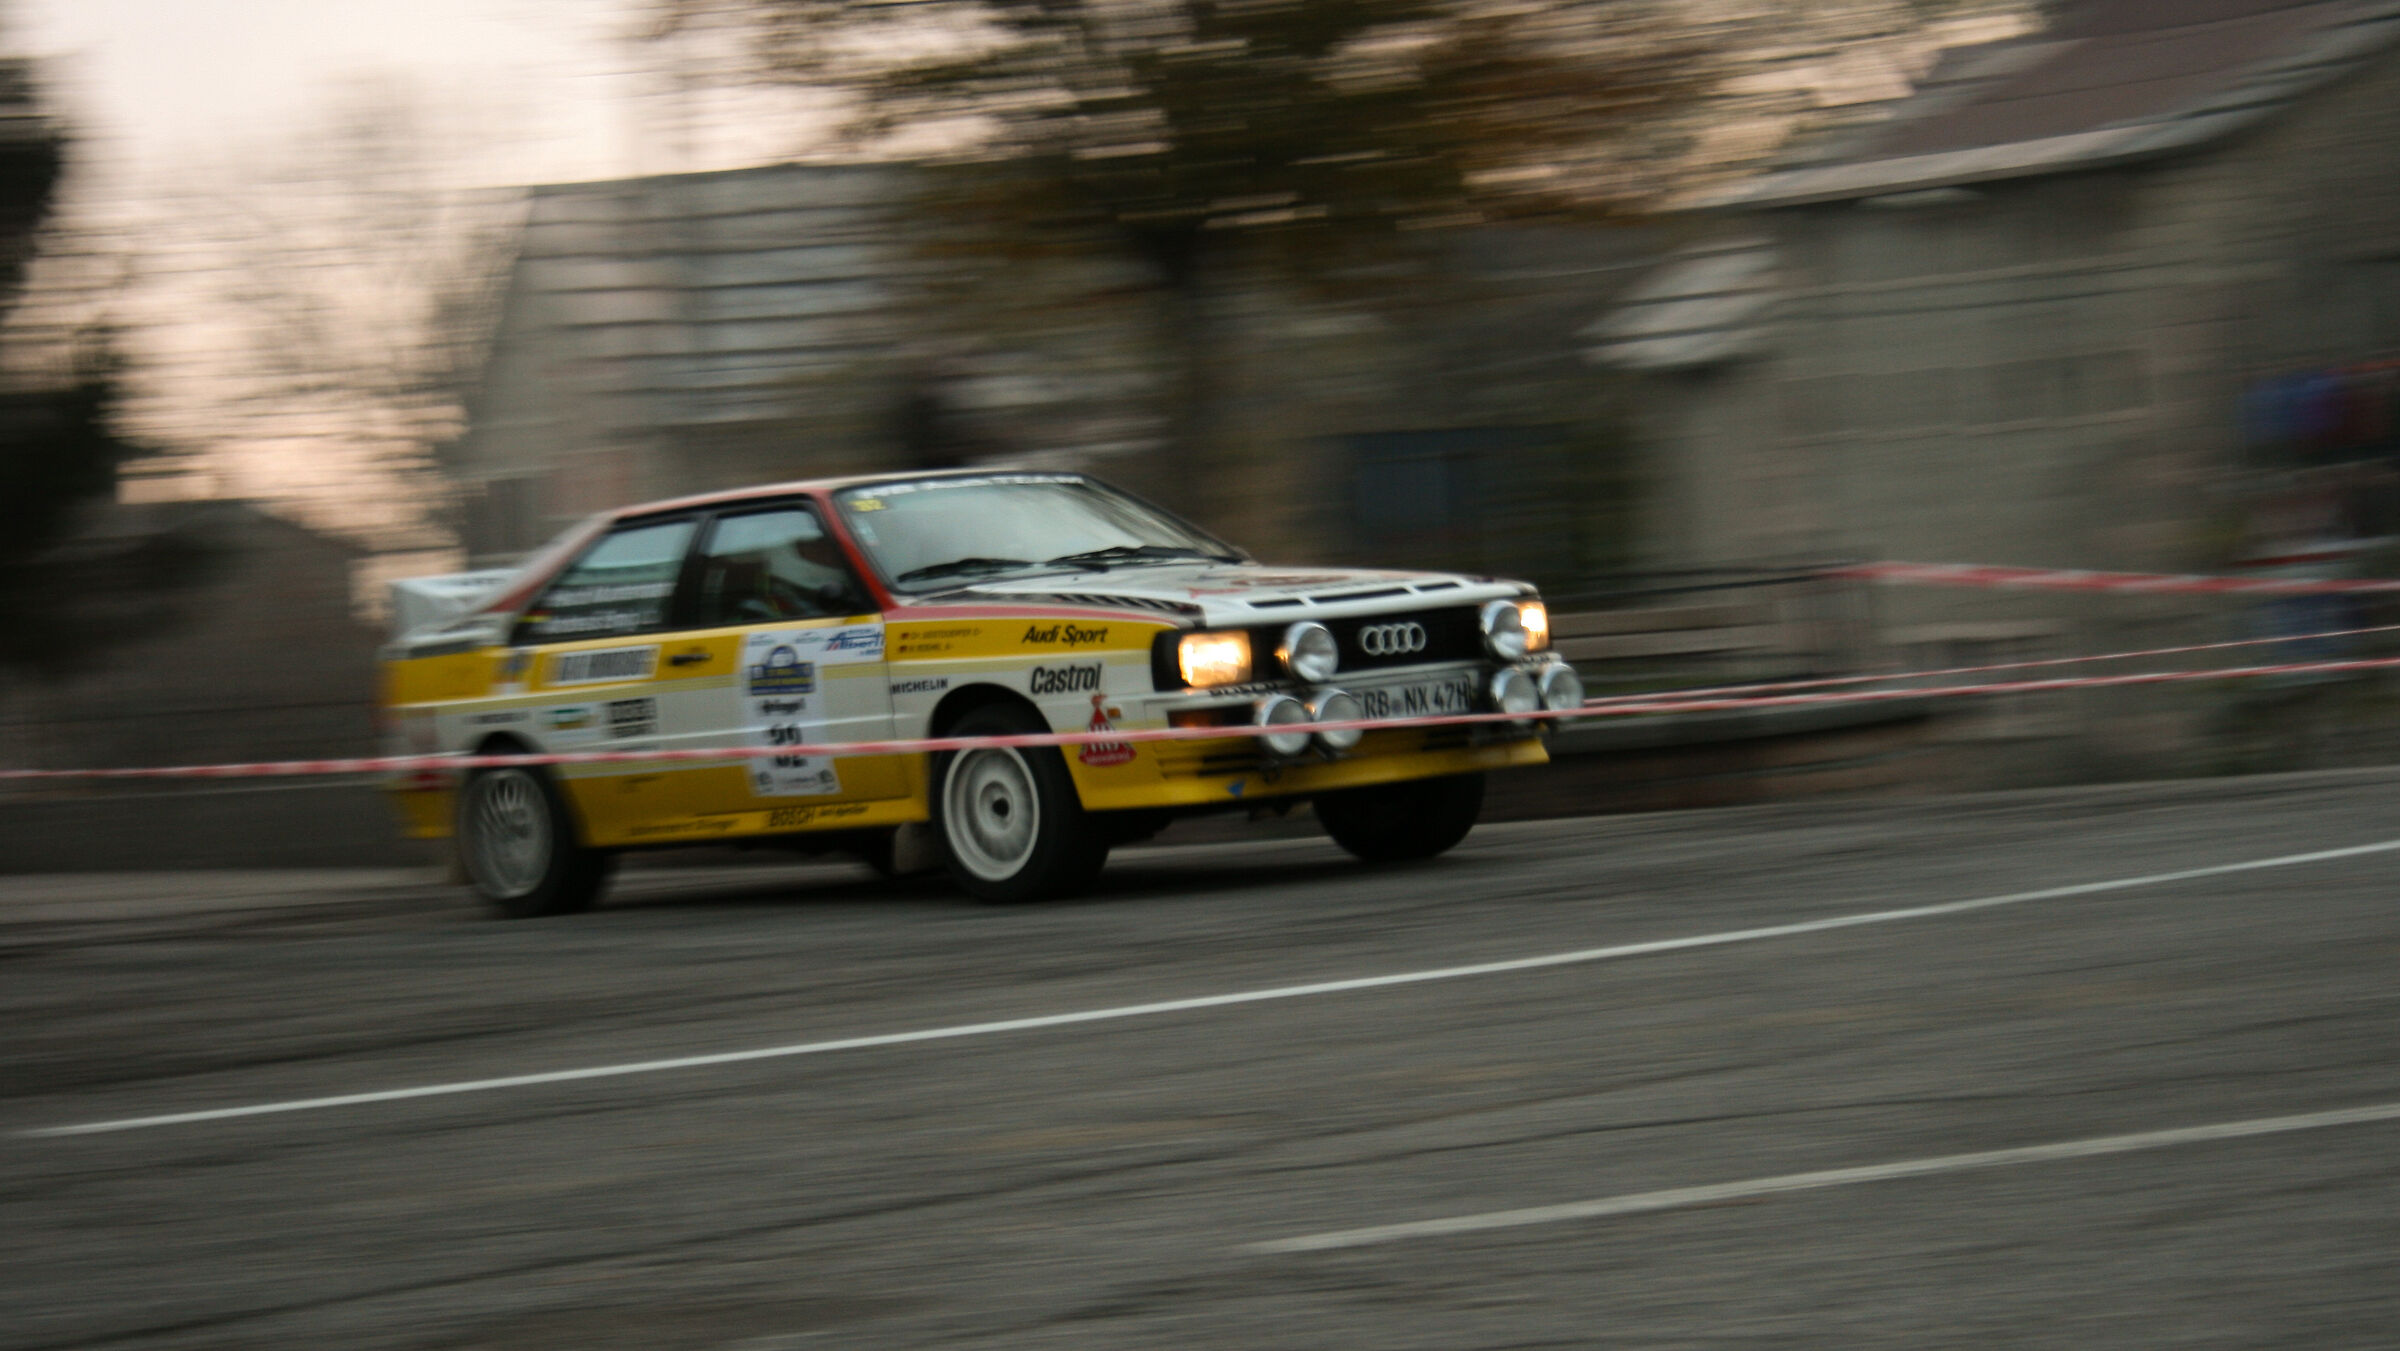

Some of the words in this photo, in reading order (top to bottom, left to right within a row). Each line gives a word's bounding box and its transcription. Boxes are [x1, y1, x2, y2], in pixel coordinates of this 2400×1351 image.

[1022, 625, 1061, 644] Audi
[1062, 624, 1108, 646] Sport
[891, 678, 949, 695] MICHELIN
[1030, 662, 1102, 694] Castrol
[1404, 686, 1430, 715] NX
[1434, 680, 1469, 711] 47H
[768, 806, 817, 828] BOSCH
